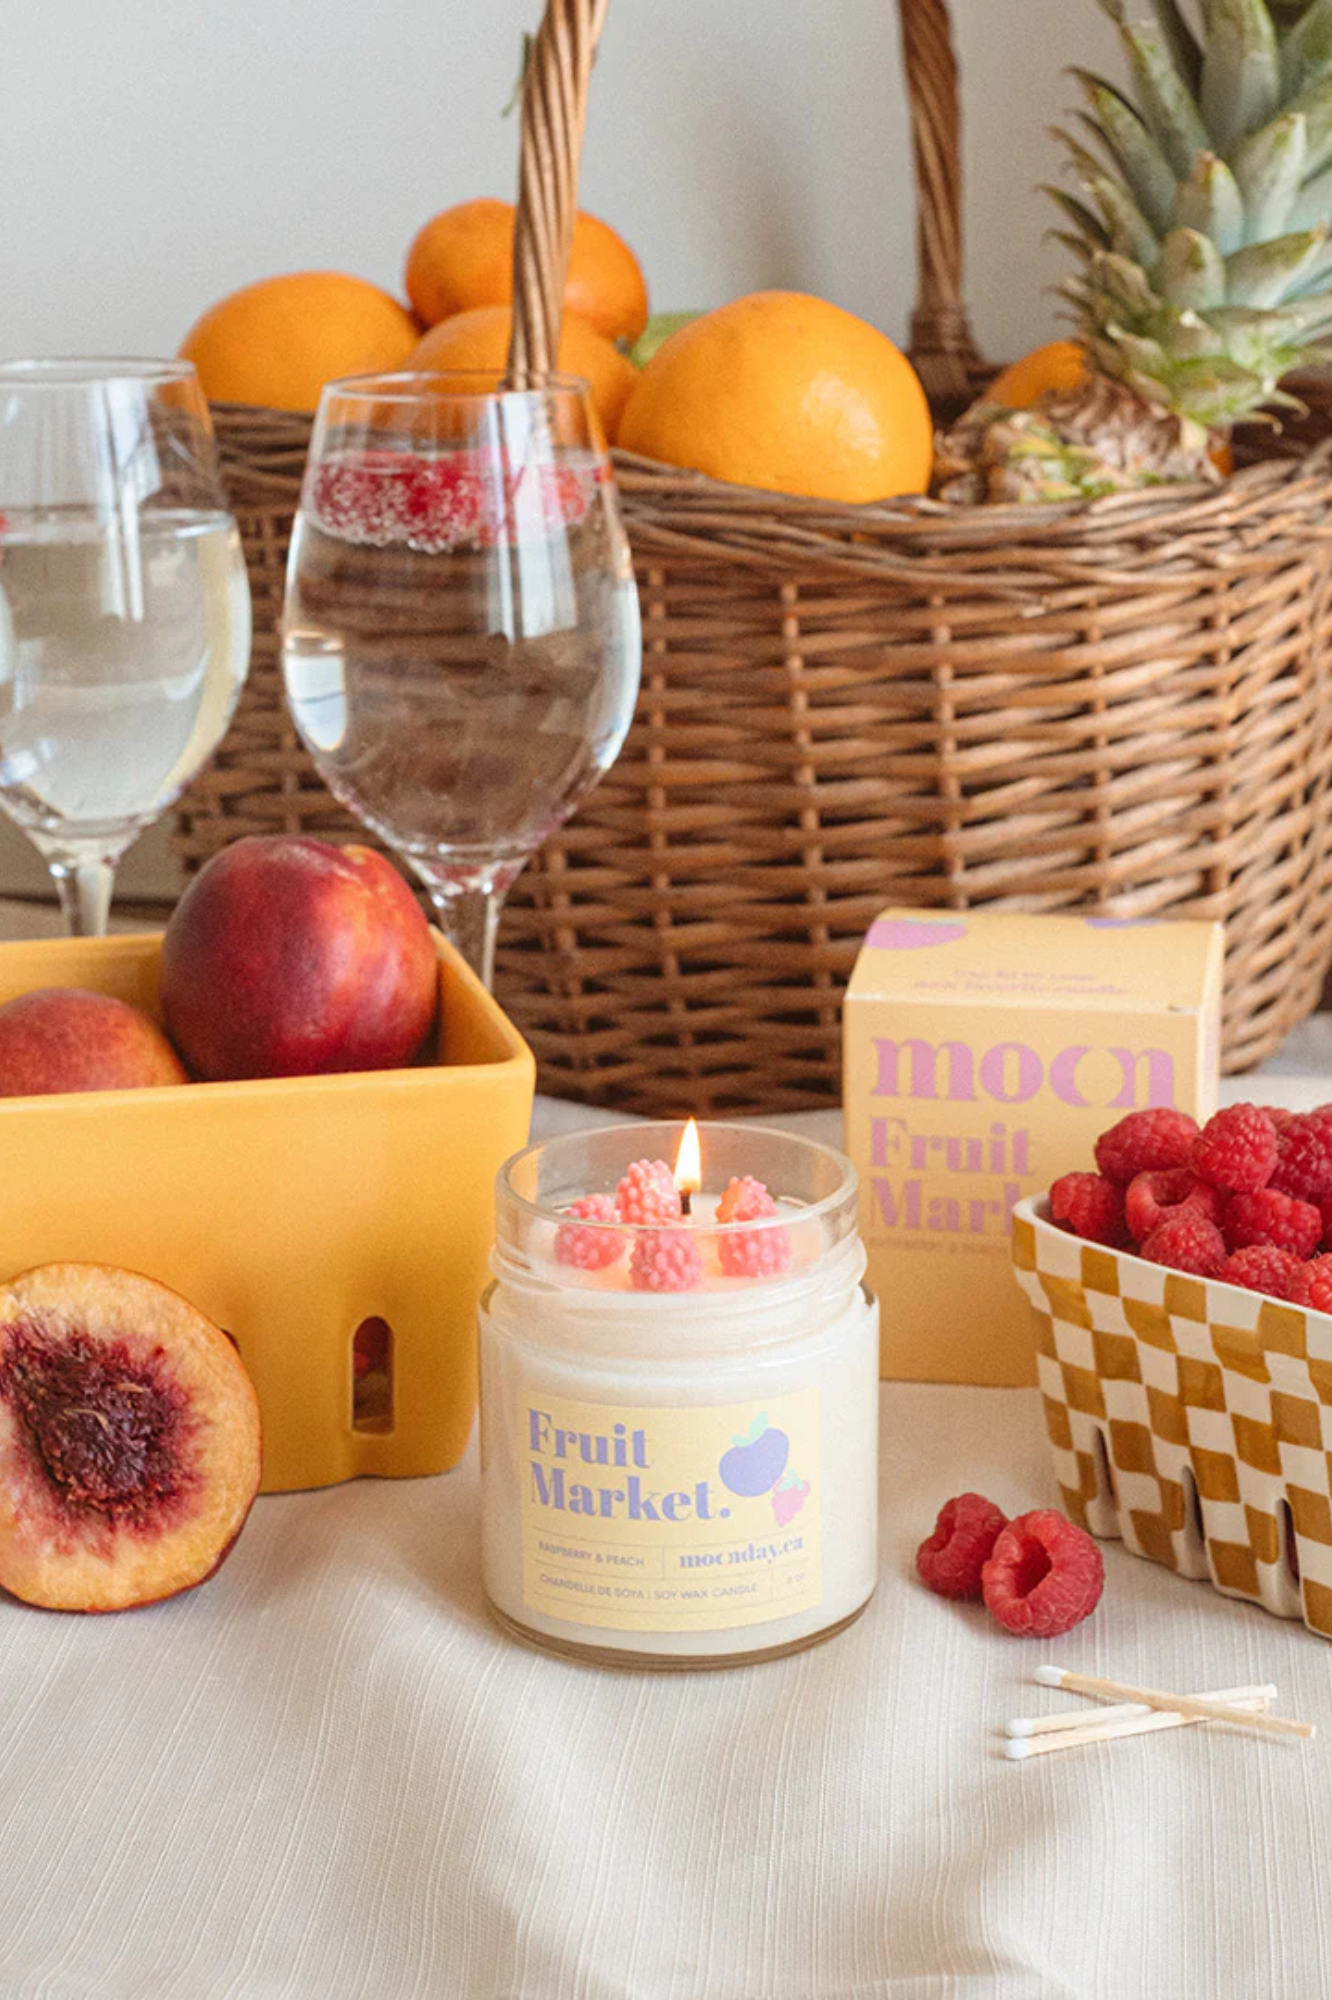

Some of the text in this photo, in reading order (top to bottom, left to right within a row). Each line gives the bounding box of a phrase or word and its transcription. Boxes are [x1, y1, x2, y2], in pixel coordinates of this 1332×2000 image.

[869, 1116, 1034, 1177] Fruit
[528, 1408, 654, 1469] Fruit
[530, 1461, 732, 1522] Market.
[538, 1540, 592, 1560] RASPBERRY
[606, 1555, 645, 1567] PEACH
[540, 1573, 595, 1593] CHANDELLE
[597, 1587, 612, 1597] DE
[614, 1588, 645, 1600] SOYA
[654, 1590, 677, 1600] SOY
[680, 1589, 709, 1599] WAX
[712, 1582, 758, 1598] CANDLE
